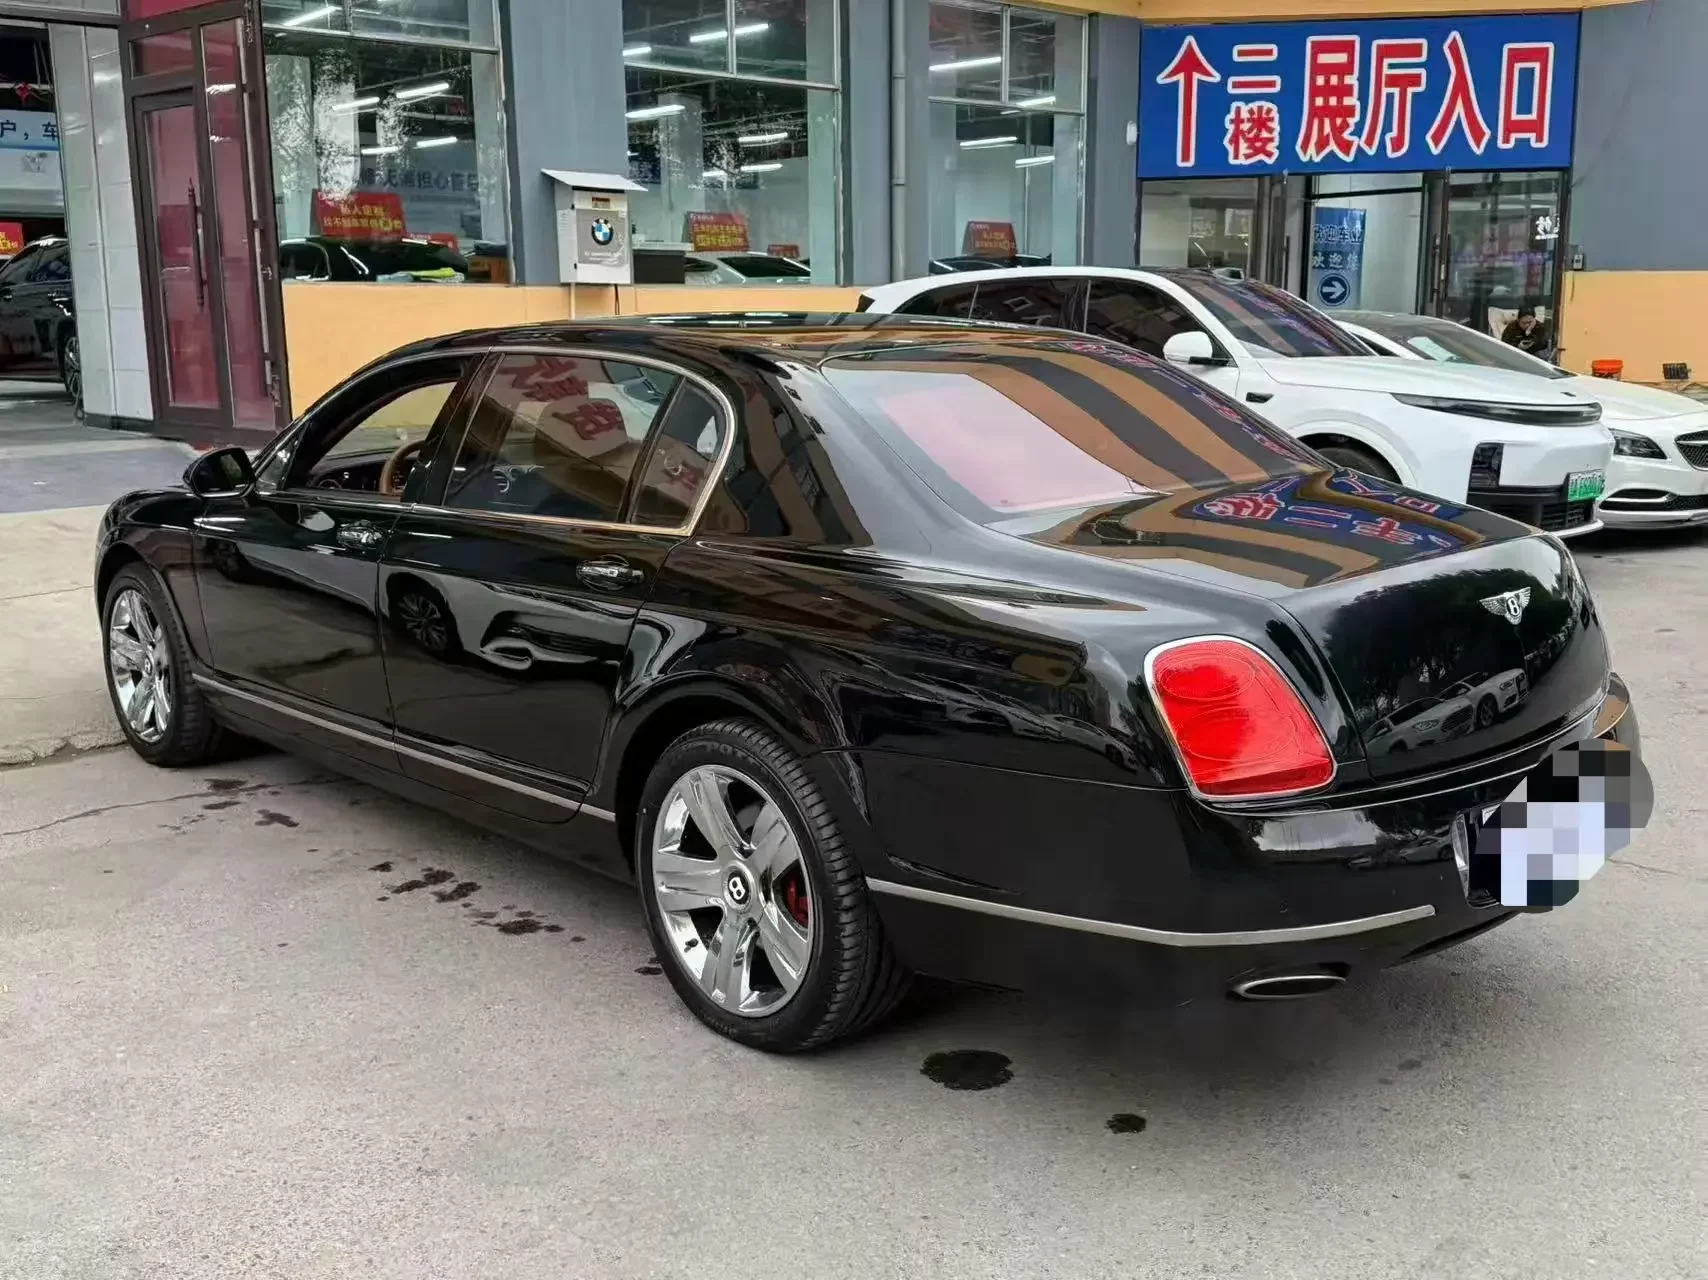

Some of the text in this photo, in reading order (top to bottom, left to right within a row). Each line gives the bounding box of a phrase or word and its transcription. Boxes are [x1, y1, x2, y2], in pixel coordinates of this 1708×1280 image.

[1224, 44, 1281, 164] 二楼
[1296, 32, 1555, 163] 展厅入口
